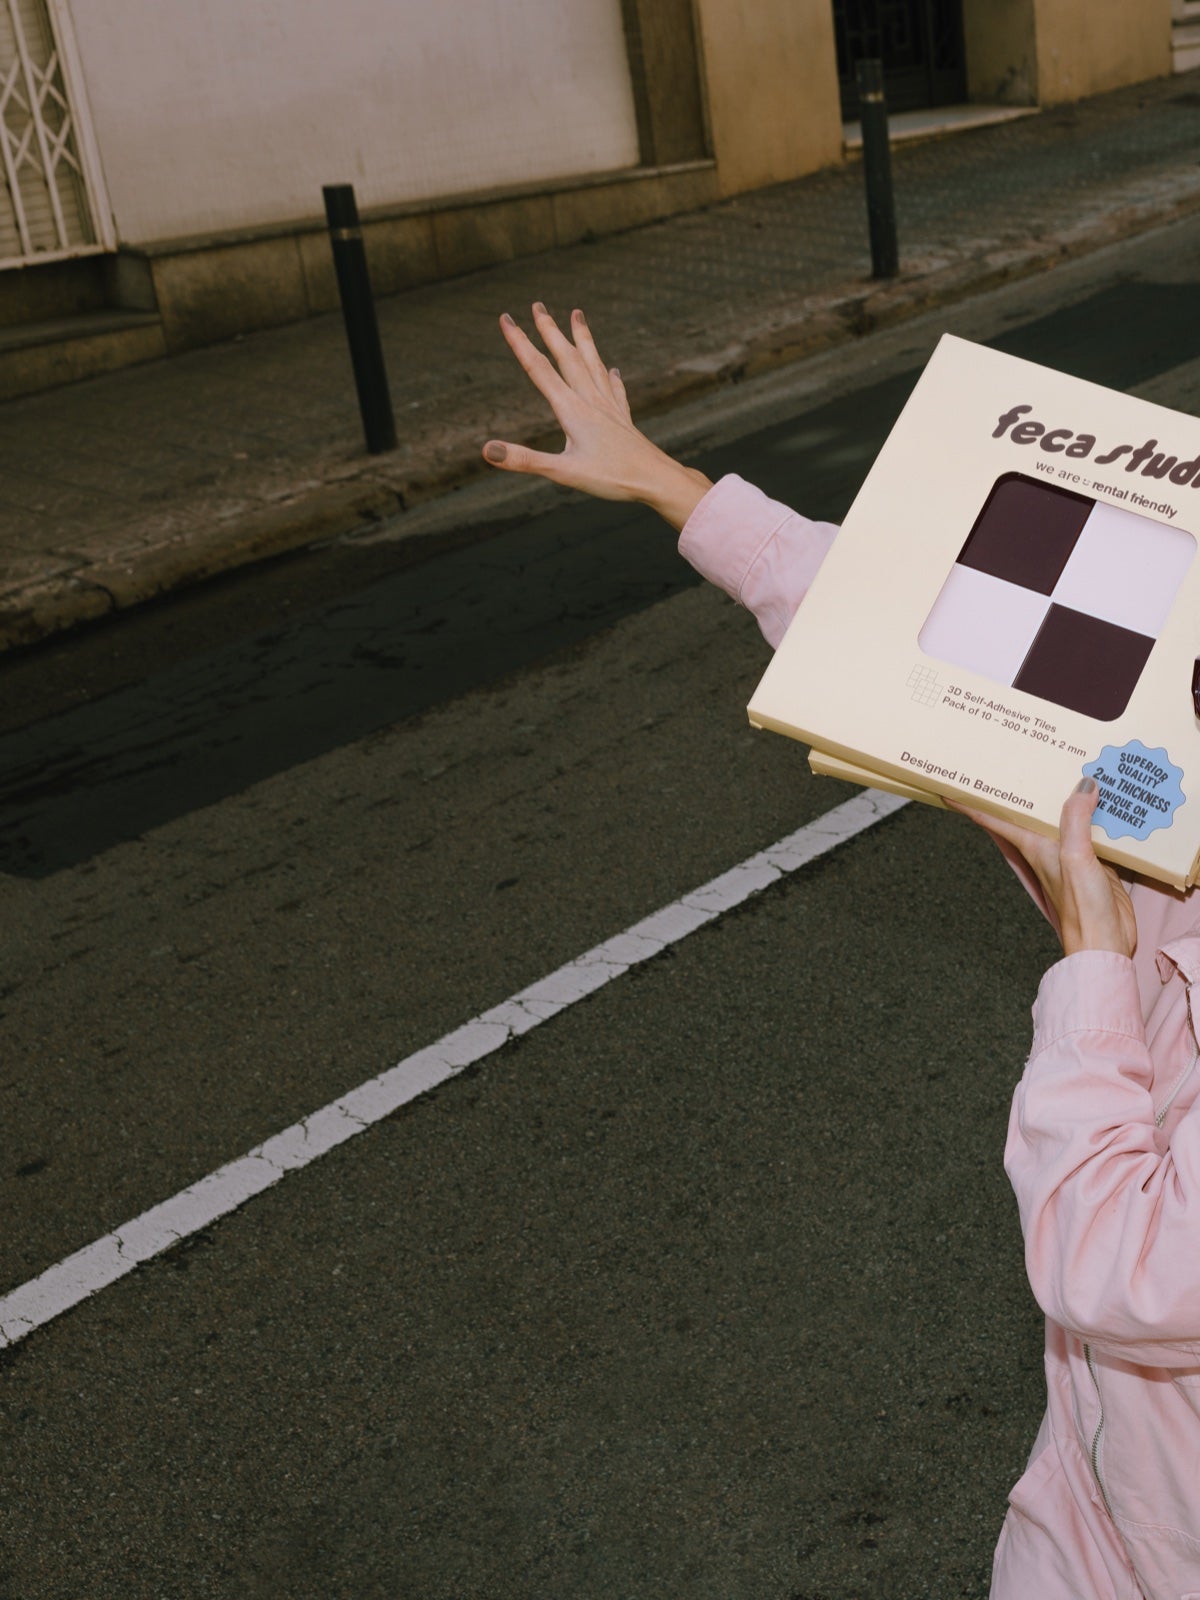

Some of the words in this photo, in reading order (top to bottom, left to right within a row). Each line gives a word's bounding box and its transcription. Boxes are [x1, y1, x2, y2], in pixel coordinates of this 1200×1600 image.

[991, 404, 1097, 459] feca
[1036, 461, 1055, 474] we
[1058, 470, 1081, 483] are
[1092, 481, 1129, 501] rental
[1130, 493, 1178, 519] friendly
[942, 696, 966, 712] Pack
[968, 706, 980, 716] of
[981, 710, 992, 721] 10
[1001, 719, 1021, 732] 300
[1029, 729, 1049, 743] 300
[1058, 740, 1066, 750] 2
[1067, 745, 1087, 758] mm
[947, 685, 963, 697] 3D
[963, 692, 1031, 723] Self-Adhesive
[1034, 717, 1057, 733] Tiles
[900, 751, 958, 781] Designed
[958, 772, 971, 786] in
[973, 779, 1035, 811] Barcelona
[1092, 767, 1116, 787] 2MM
[1117, 778, 1171, 813] THICKNESS
[1117, 763, 1161, 789] QUALITY
[1119, 752, 1168, 783] SUPERIOR
[1098, 787, 1133, 811] UNIQUE
[1132, 804, 1149, 819] ON
[1107, 805, 1147, 829] MARKET
